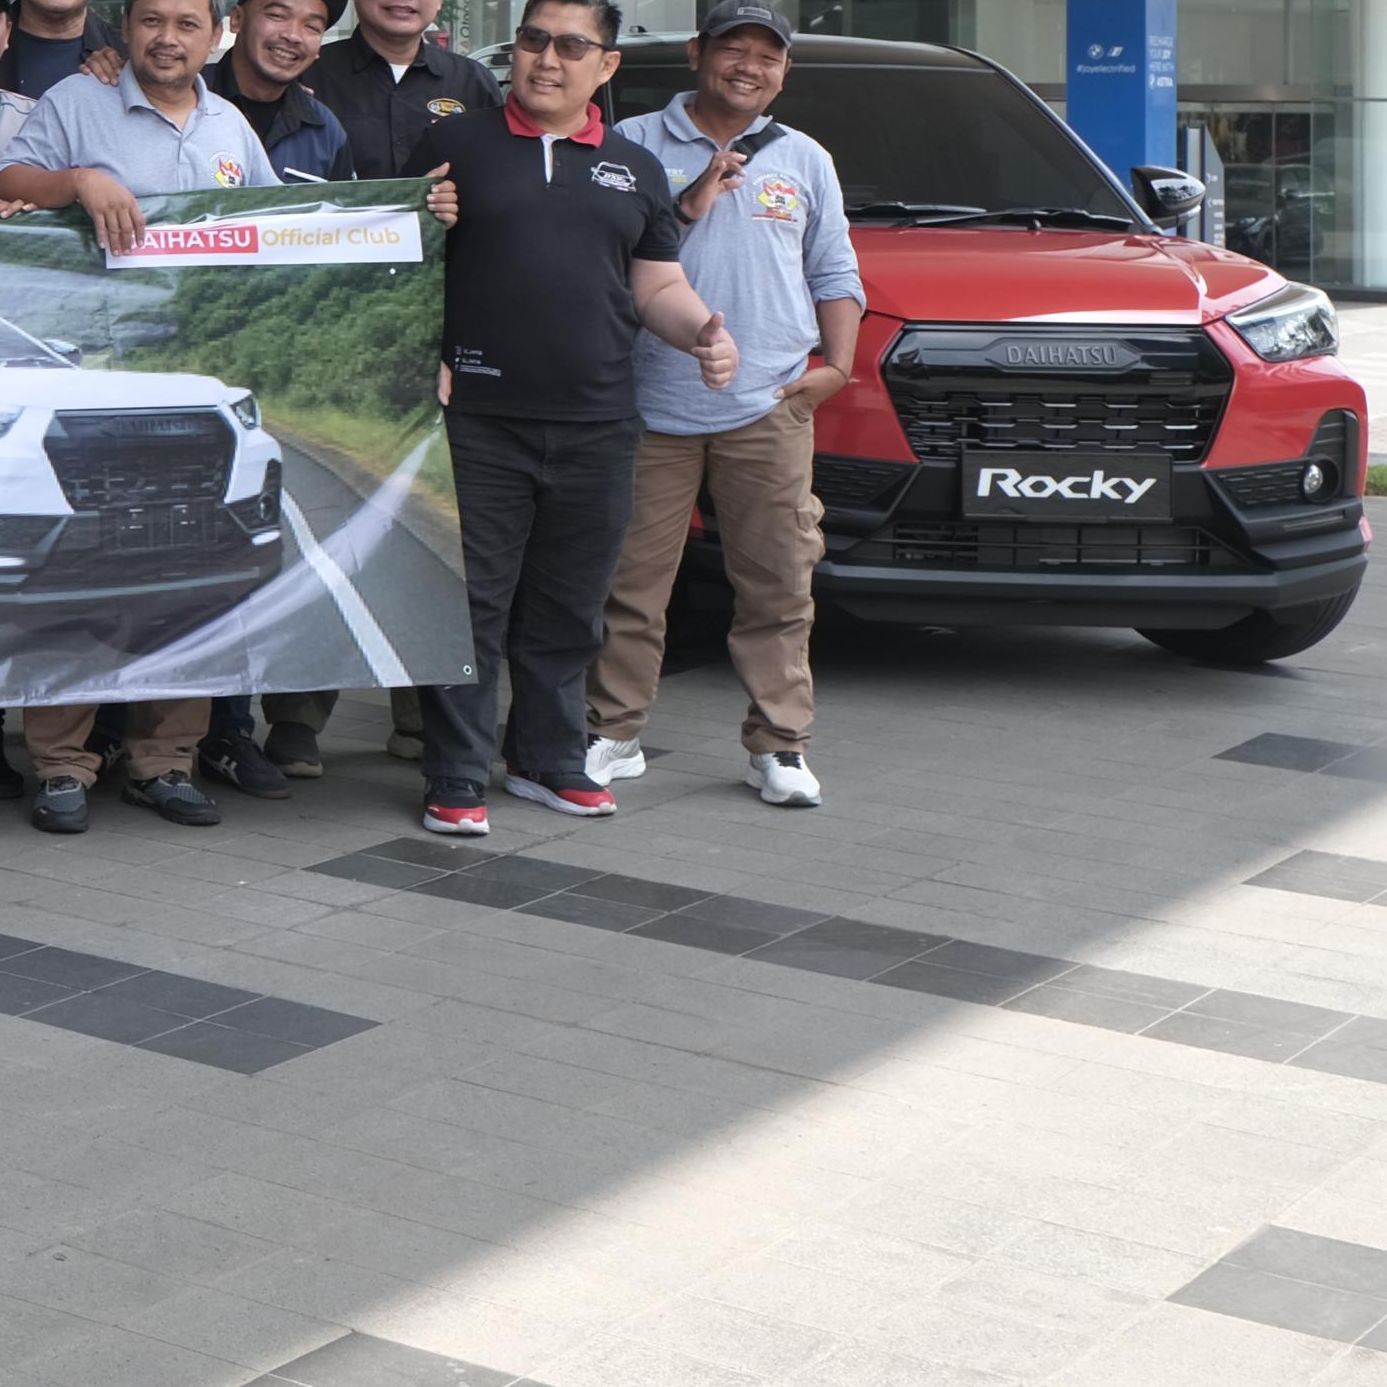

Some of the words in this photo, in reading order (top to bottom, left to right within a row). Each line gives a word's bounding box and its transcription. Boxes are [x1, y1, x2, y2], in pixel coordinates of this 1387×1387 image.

[131, 229, 251, 252] AIHATSU
[261, 227, 340, 247] Official
[347, 225, 400, 245] Club
[1006, 345, 1118, 364] DAIHATSU
[976, 467, 1158, 504] Rocky
